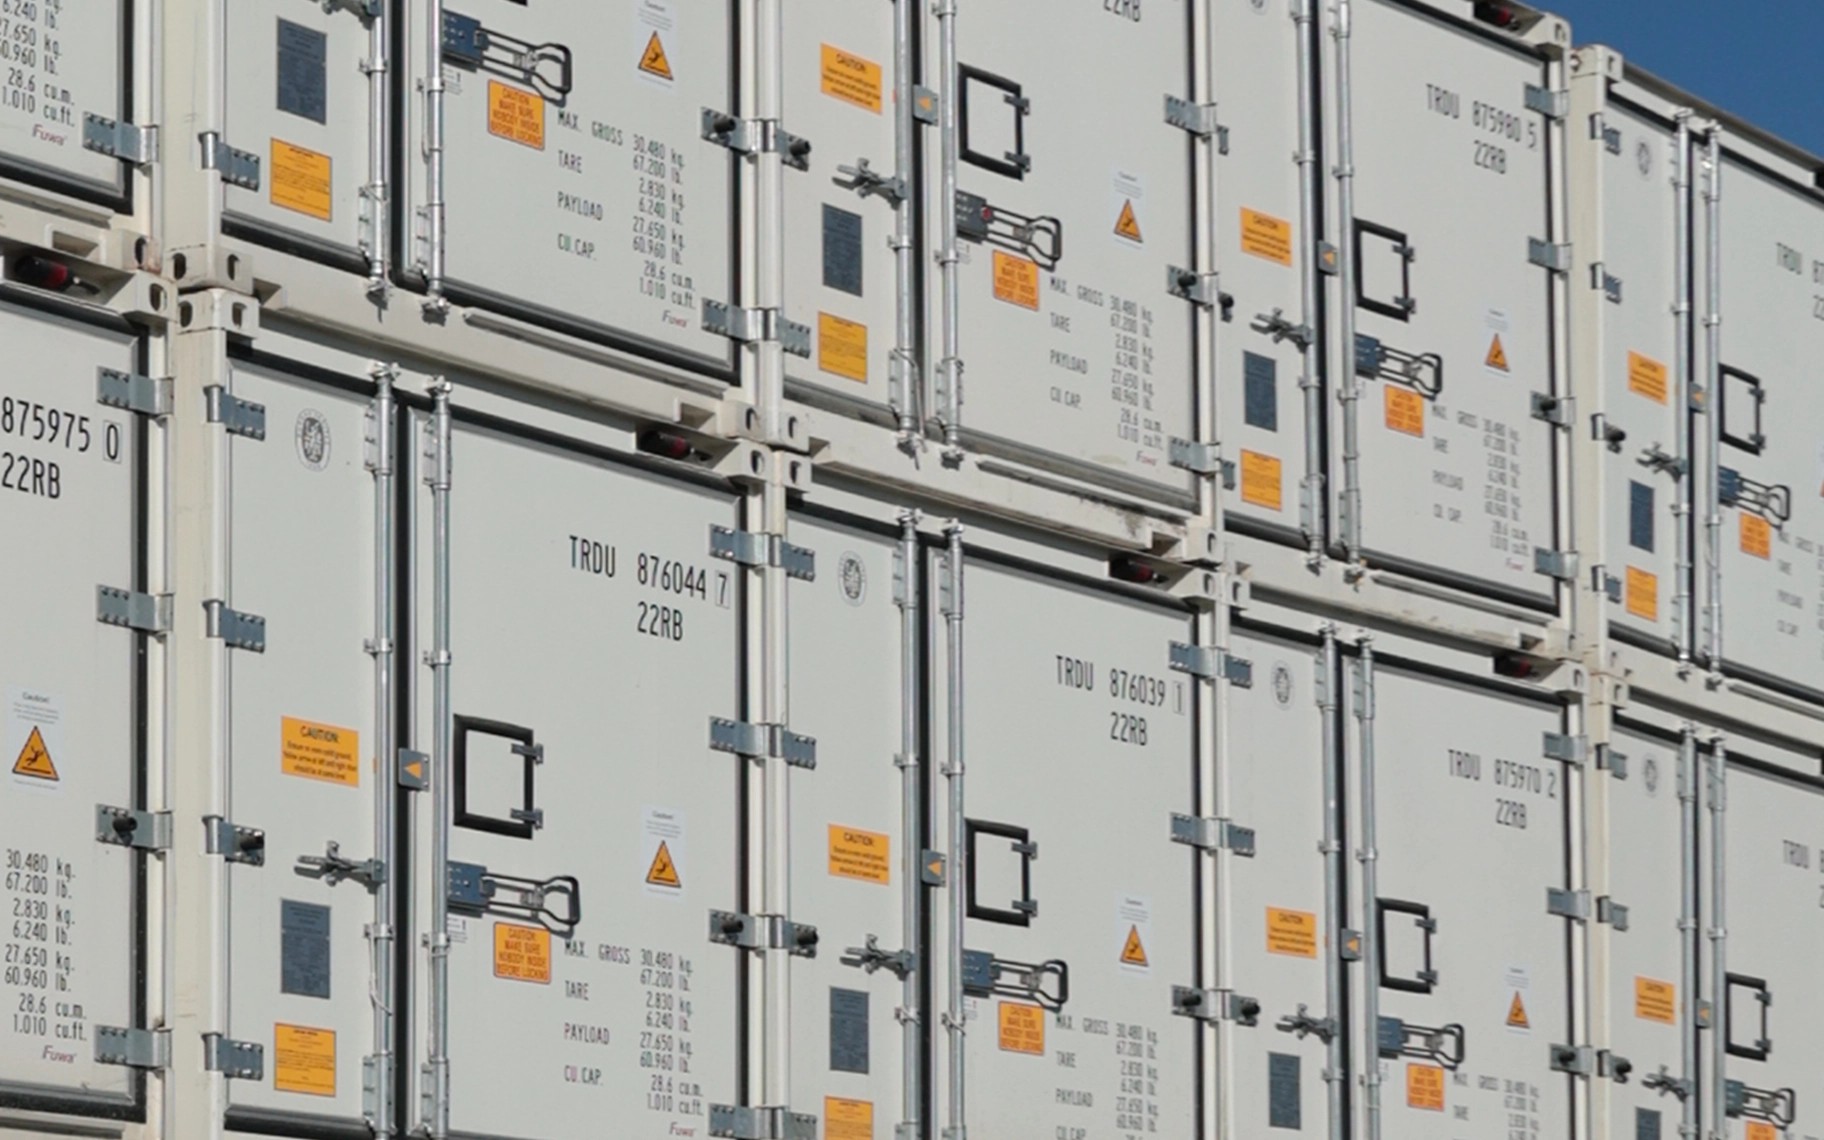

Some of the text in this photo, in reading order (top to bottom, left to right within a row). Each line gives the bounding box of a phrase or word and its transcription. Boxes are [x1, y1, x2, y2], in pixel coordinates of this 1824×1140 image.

[44, 33, 62, 62] kg.
[44, 54, 58, 76] lb.
[8, 67, 75, 105] 28.6 cu.m.
[2, 86, 75, 127] 1.010 cu.ft.
[558, 109, 582, 132] MAX.
[591, 121, 623, 146] GROSS
[633, 134, 666, 160] 30.480
[558, 150, 582, 174] TARE
[633, 156, 666, 180] 67.200
[639, 178, 666, 201] 2.830
[557, 192, 603, 221] PAYLOAD
[639, 199, 666, 222] 6.240
[633, 216, 666, 241] 27.650
[633, 236, 666, 261] 60.960
[644, 259, 666, 281] 28.6
[640, 278, 666, 300] 1.010
[1050, 349, 1088, 374] PAYLOAD
[1, 396, 90, 452] 875975
[106, 423, 119, 460] 0
[1, 451, 60, 499] 22RB
[569, 535, 727, 604] TRDU 876044 7
[637, 601, 683, 641] 22RB
[1057, 655, 1093, 691] TRDU
[1110, 668, 1165, 707] 876039
[1110, 711, 1147, 746] 22RB
[6, 849, 48, 874] 30.480
[56, 857, 76, 881] kg.
[5, 870, 73, 900] 67.200 lb.
[12, 897, 75, 931] 2.830 kg.
[12, 921, 72, 946] 6.240 lb.
[4, 943, 75, 977] 27.650 kg.
[564, 942, 588, 958] MAX.
[598, 944, 630, 965] GROSS
[640, 949, 673, 970] 30.480
[4, 967, 71, 993] 60.960 lb.
[565, 981, 589, 1001] TARE
[640, 970, 673, 990] 67.200
[18, 993, 87, 1019] 28.6 cu.m.
[646, 991, 673, 1011] 2.830
[12, 1013, 87, 1042] 1.010 cu.ft.
[564, 1023, 610, 1045] PAYLOAD
[646, 1013, 673, 1031] 6.240
[640, 1032, 673, 1051] 27.650
[640, 1052, 673, 1071] 60.960
[651, 1075, 673, 1093] 28.6
[647, 1094, 673, 1112] 1.010
[1056, 1088, 1093, 1108] PAYLOAD
